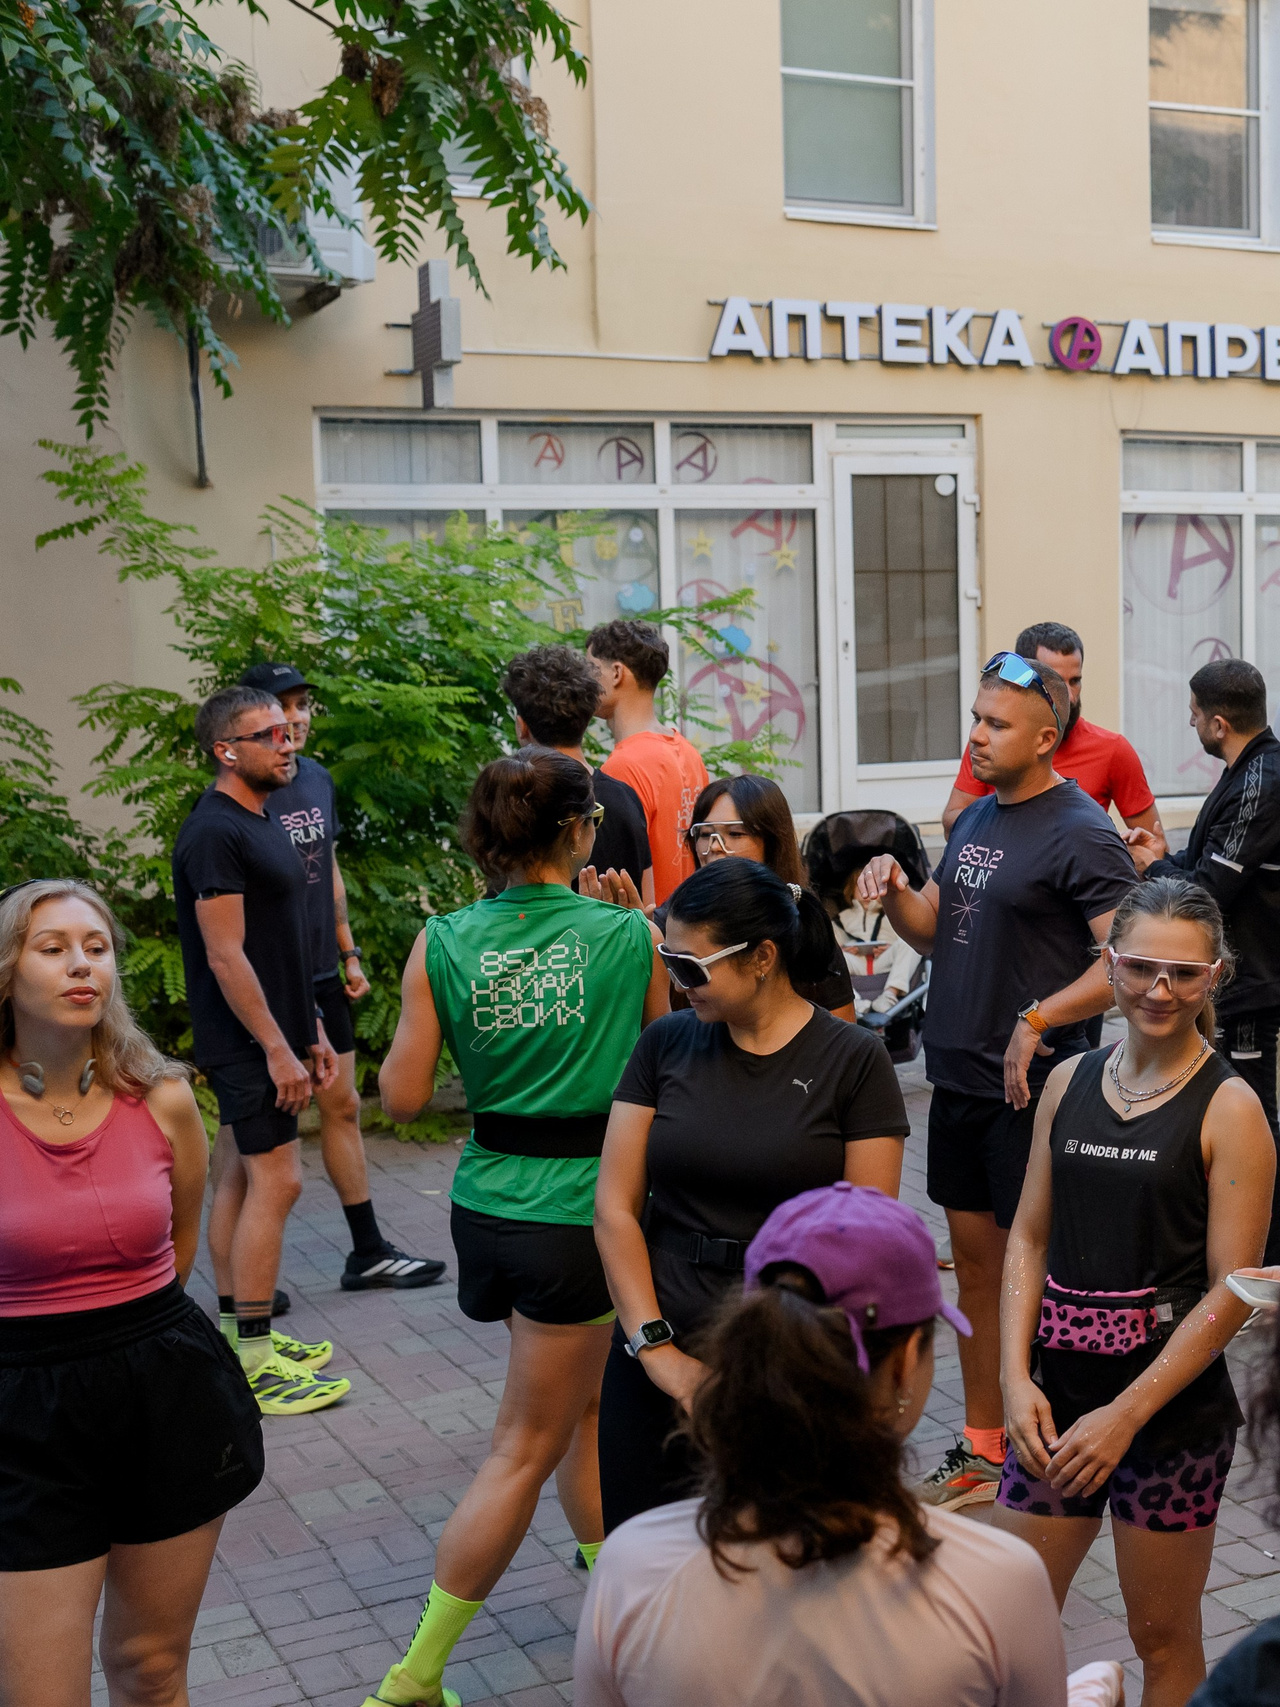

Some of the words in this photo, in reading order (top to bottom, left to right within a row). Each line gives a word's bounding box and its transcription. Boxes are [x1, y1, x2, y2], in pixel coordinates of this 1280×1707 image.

[710, 297, 1036, 368] АПТЕКА
[959, 843, 1004, 869] 8512
[480, 944, 570, 976] 8512
[473, 998, 585, 1030] СВОИХ
[1080, 1143, 1119, 1159] UNDER
[1121, 1148, 1138, 1159] BY
[1138, 1149, 1158, 1161] ME
